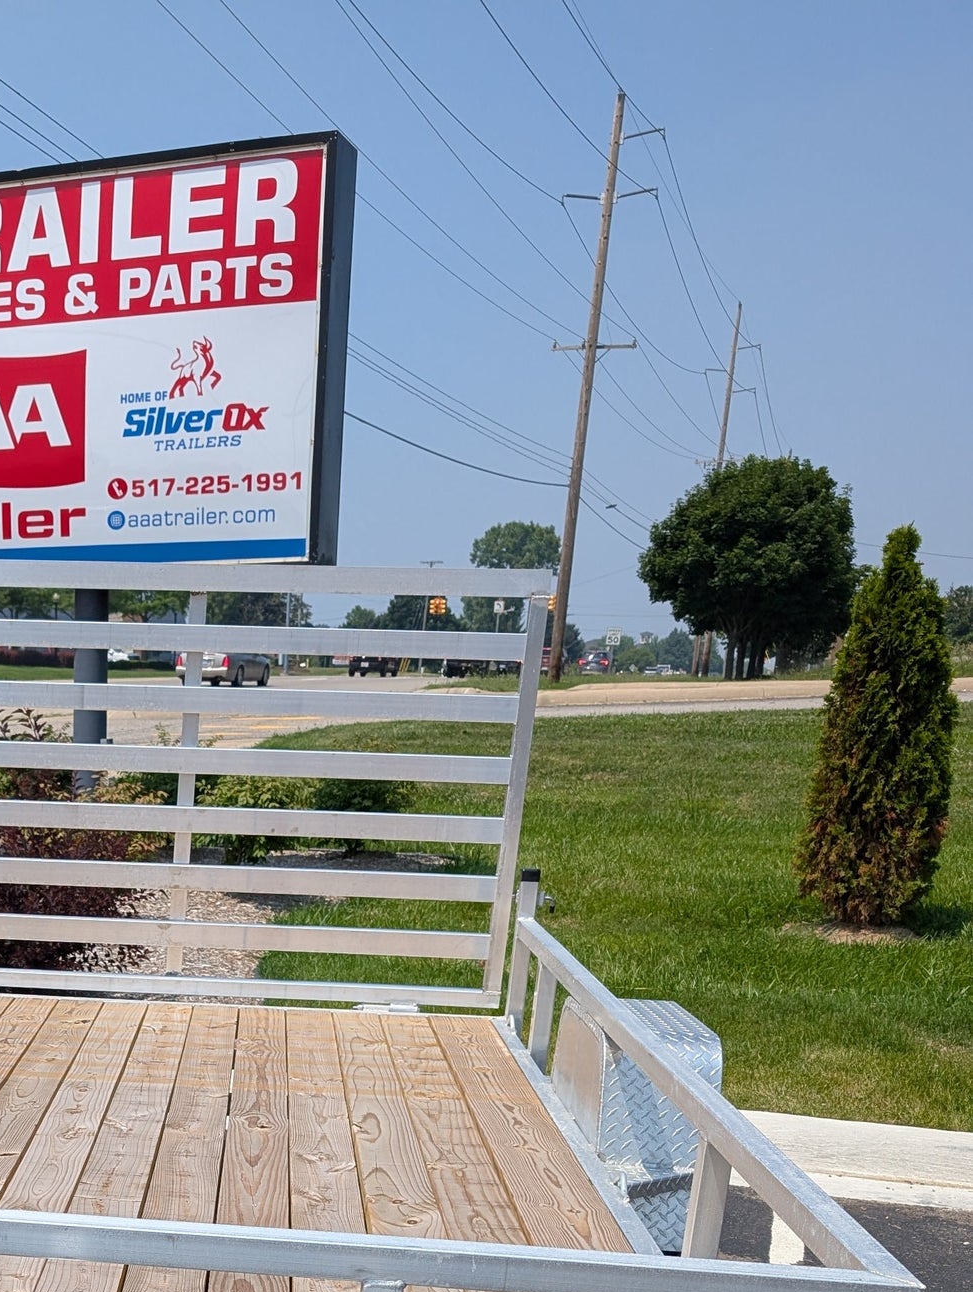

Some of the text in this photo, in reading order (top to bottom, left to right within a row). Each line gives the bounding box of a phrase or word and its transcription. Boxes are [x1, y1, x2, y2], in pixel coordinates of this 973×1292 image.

[64, 273, 99, 315] &
[118, 252, 294, 311] PARTS
[120, 390, 168, 404] HOME OF
[154, 434, 242, 451] TRAILERS
[131, 471, 302, 498] 517-225-1991
[128, 507, 275, 528] aaatrailer.com
